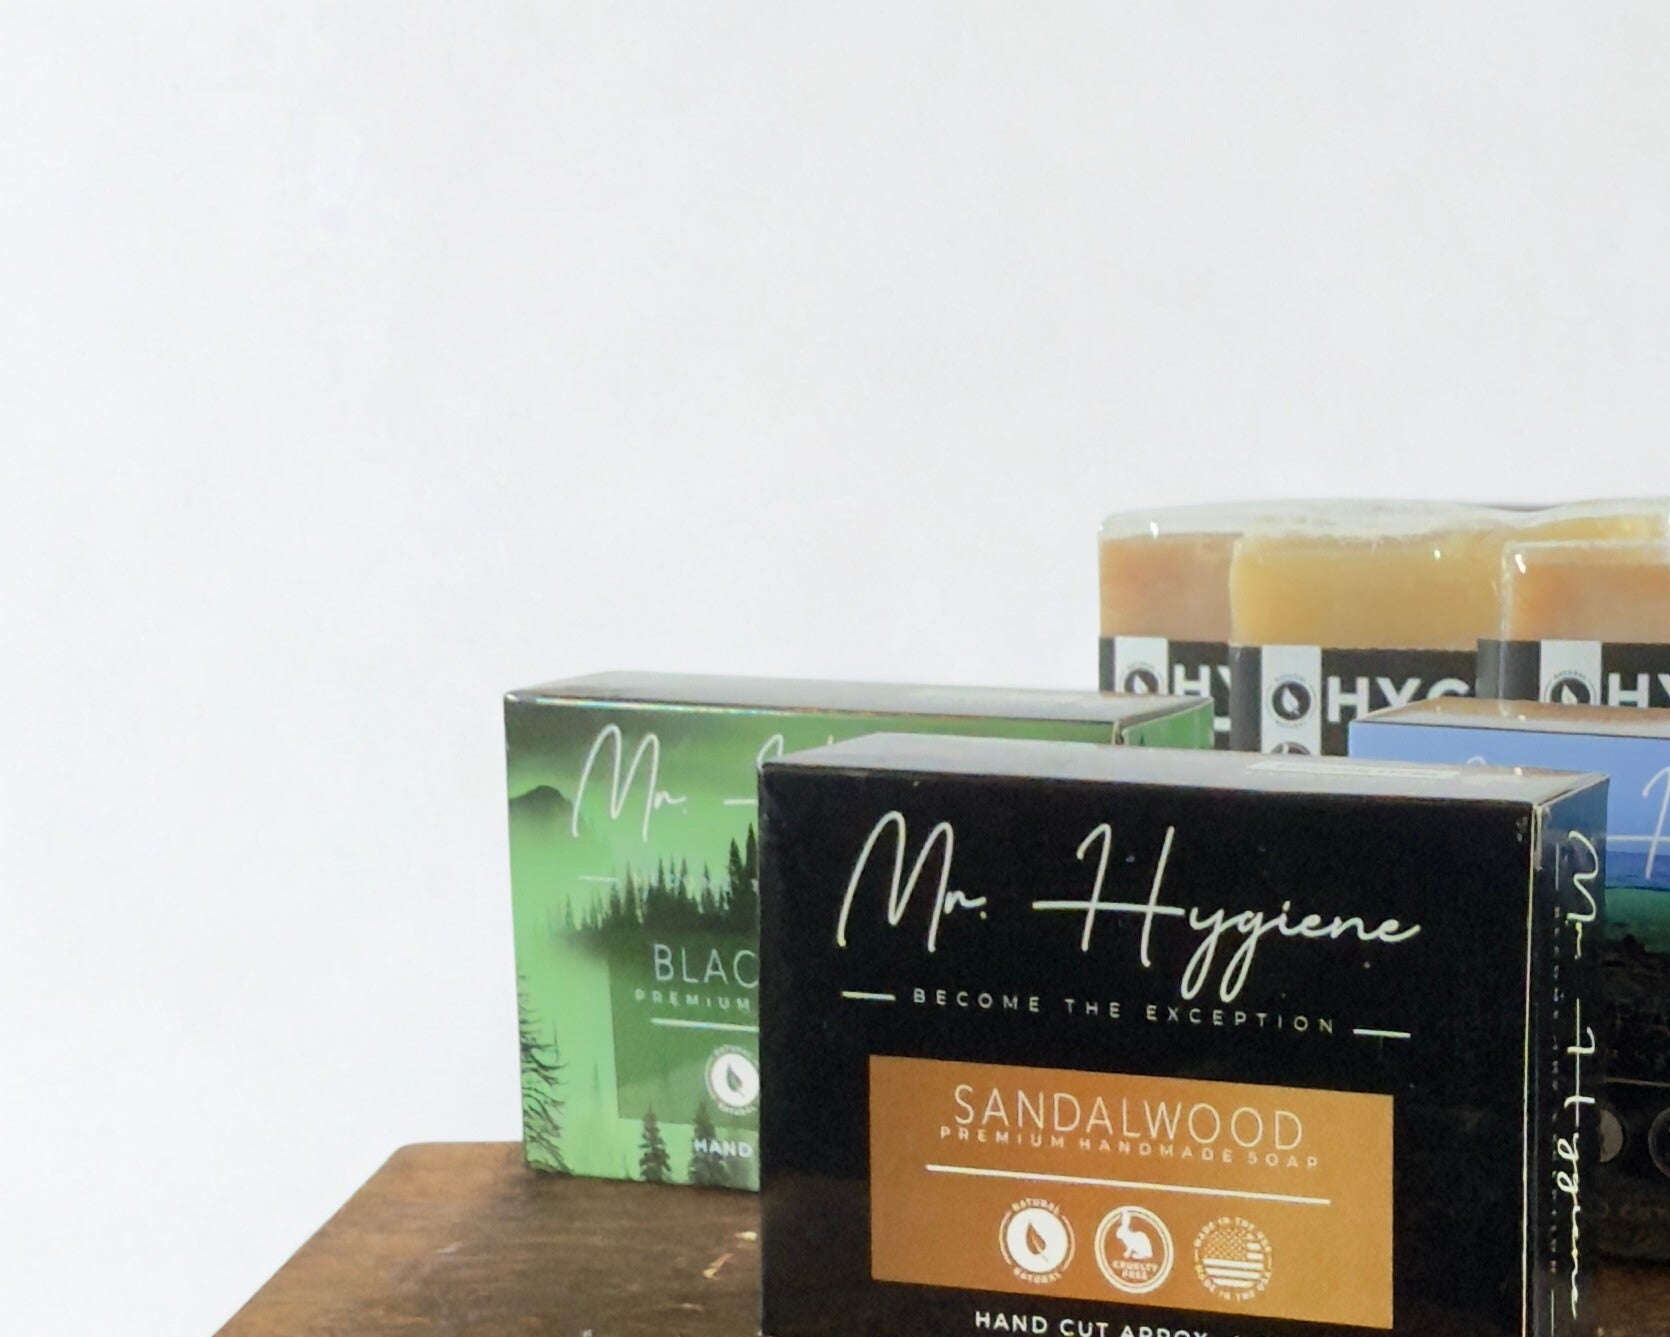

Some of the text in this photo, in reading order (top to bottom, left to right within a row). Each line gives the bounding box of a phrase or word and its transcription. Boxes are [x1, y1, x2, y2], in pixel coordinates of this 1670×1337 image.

[571, 722, 687, 843] Mr.
[836, 810, 1420, 1002] Mr. Hygiene
[653, 943, 759, 989] BLAC
[634, 989, 751, 1012] PREMIUM
[914, 988, 1334, 1034] BECOME THE EXCEPTION
[953, 1084, 1303, 1150] SANDALWOOD
[693, 1137, 753, 1159] HAND
[940, 1125, 1319, 1169] PREMIUM HANDMADE SOAP
[1556, 998, 1597, 1320] Hygiene
[975, 1311, 1048, 1333] HAND
